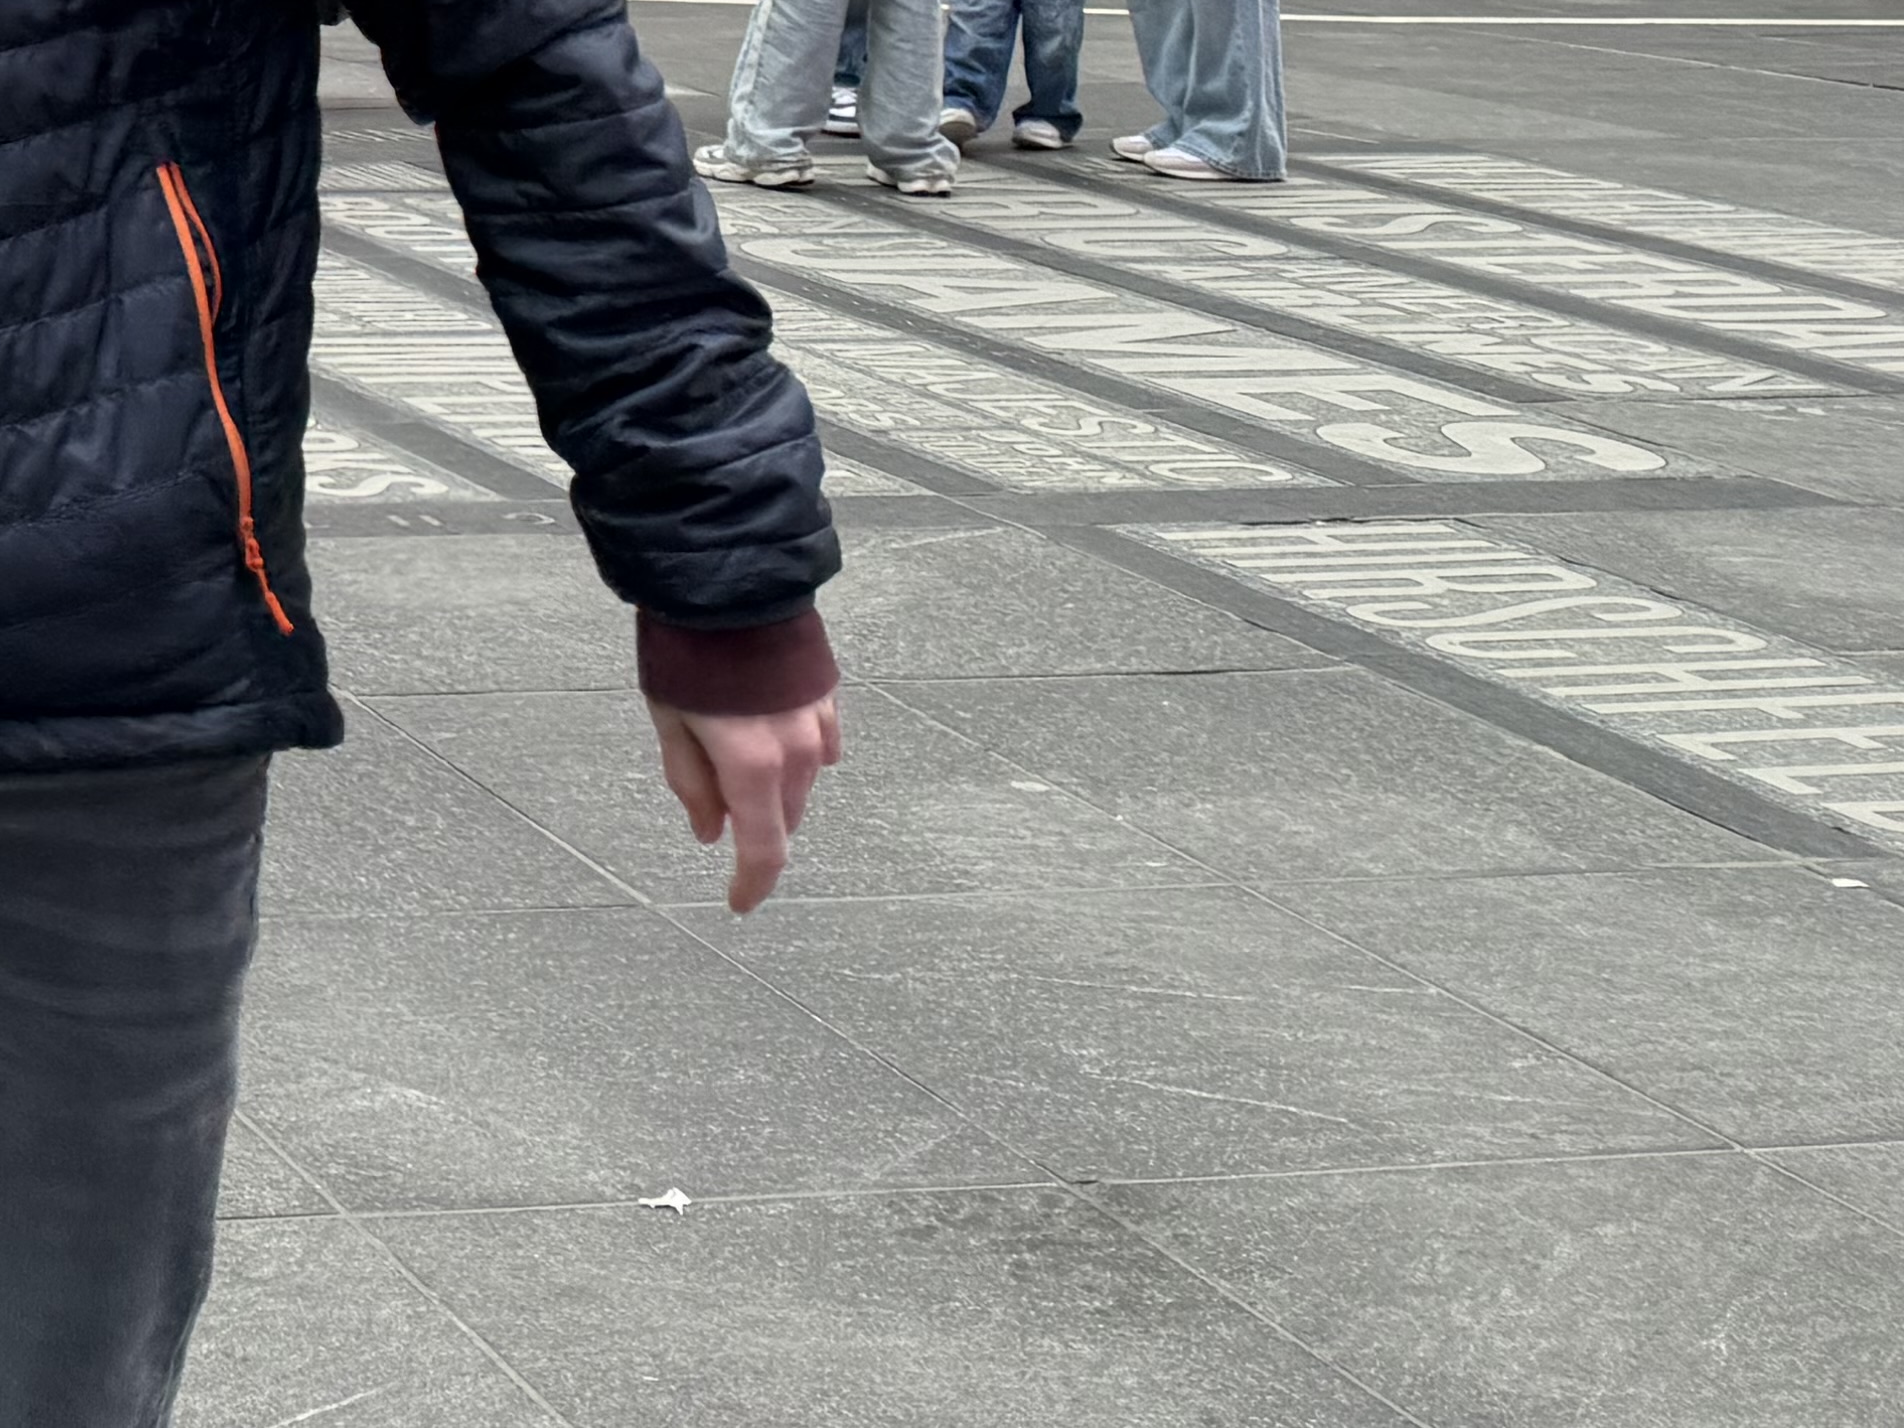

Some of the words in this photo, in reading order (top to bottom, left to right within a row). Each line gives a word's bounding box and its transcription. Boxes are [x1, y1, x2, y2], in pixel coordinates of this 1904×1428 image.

[741, 241, 1667, 476] JAMES
[1128, 261, 1683, 395] AIRLINES
[1260, 257, 1838, 393] AMERICAN
[829, 342, 1293, 484] MAJESTIC
